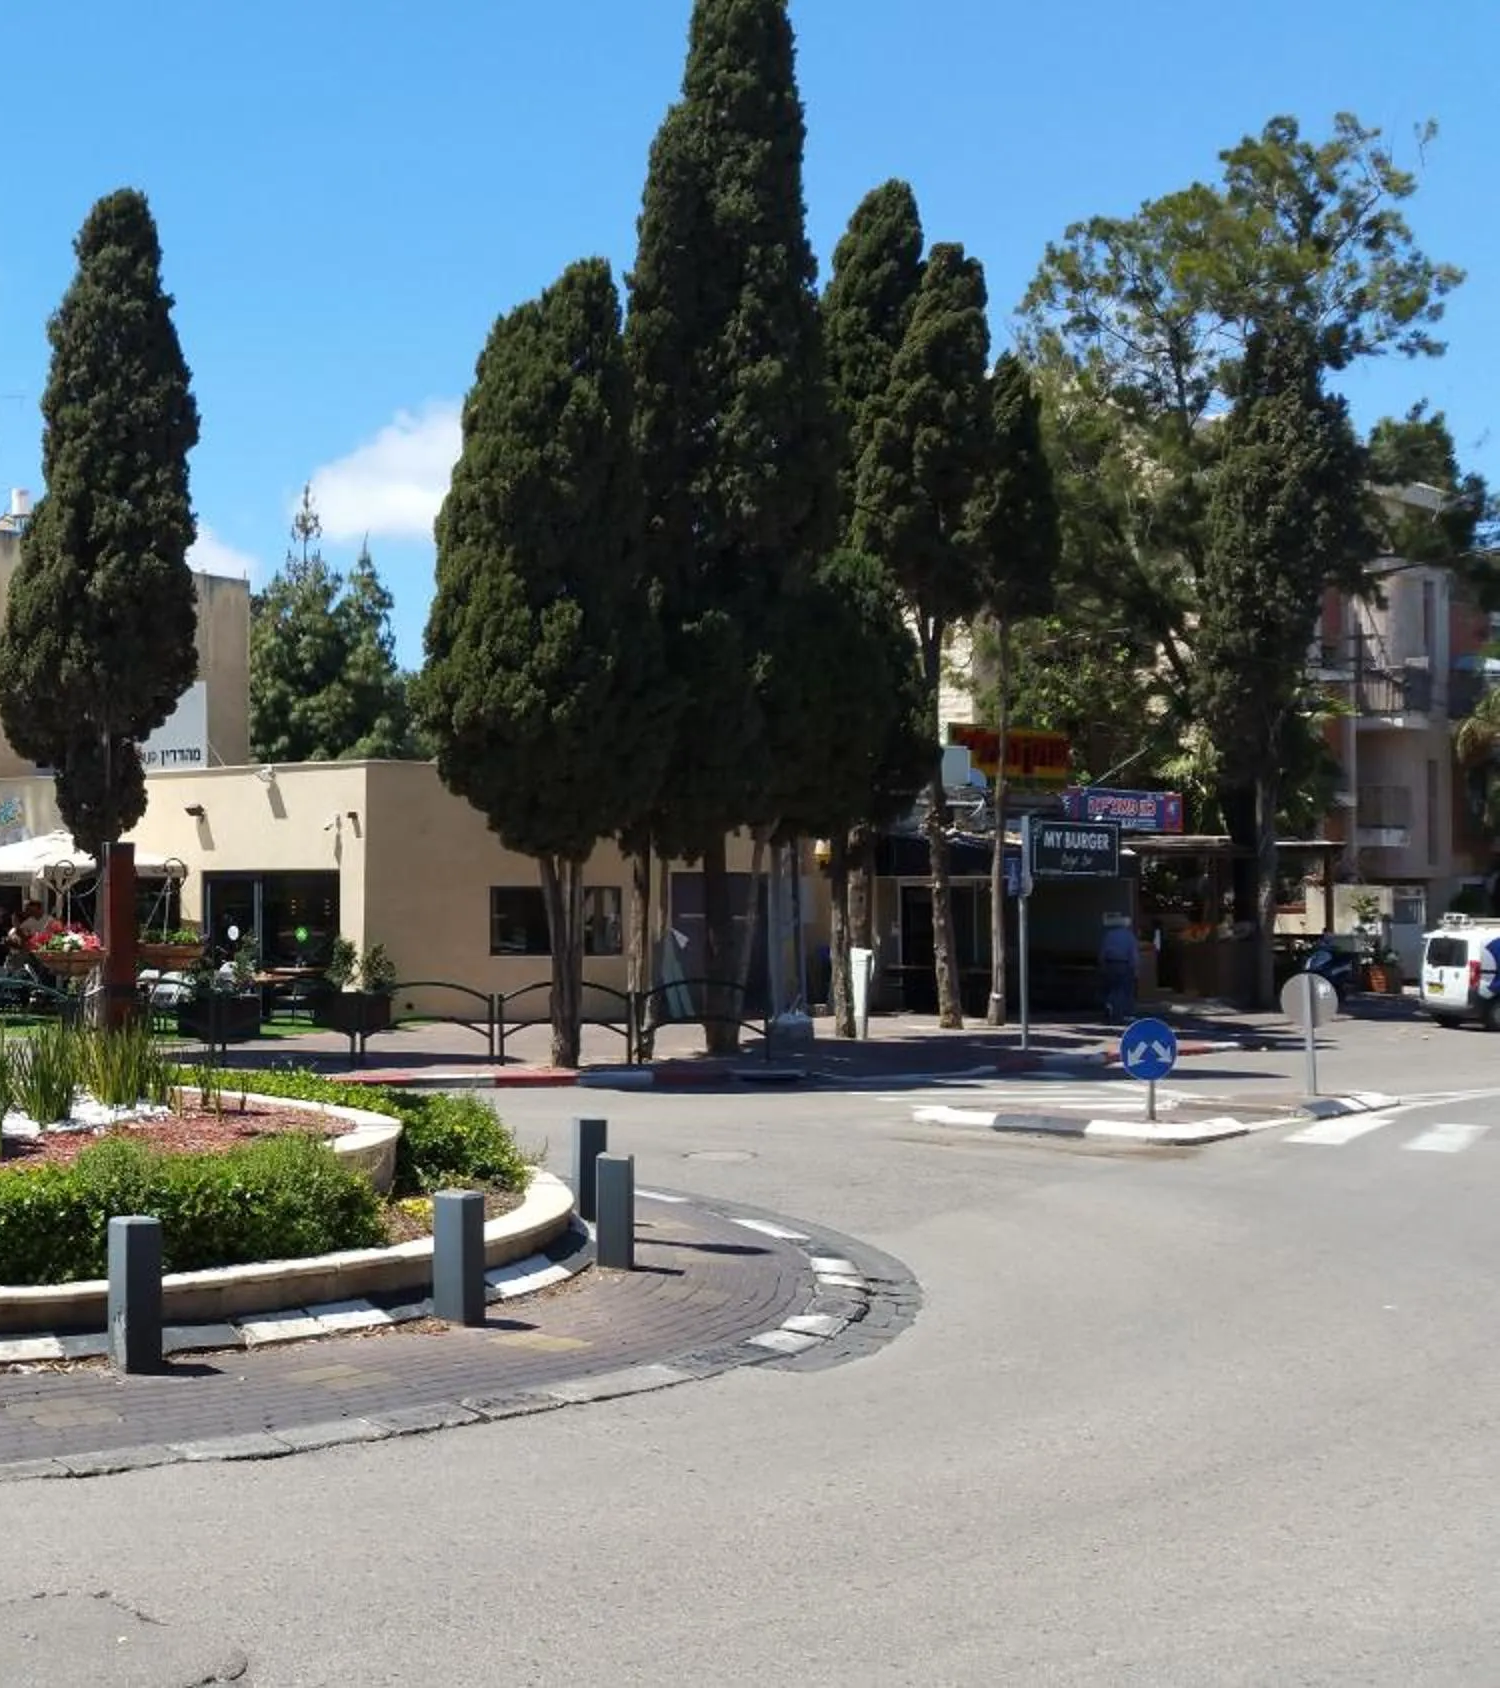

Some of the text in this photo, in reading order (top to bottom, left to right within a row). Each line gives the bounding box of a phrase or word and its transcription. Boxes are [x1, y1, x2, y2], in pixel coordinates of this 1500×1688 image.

[161, 748, 201, 767] מהדרין
[1043, 831, 1109, 850] MY BURGER
